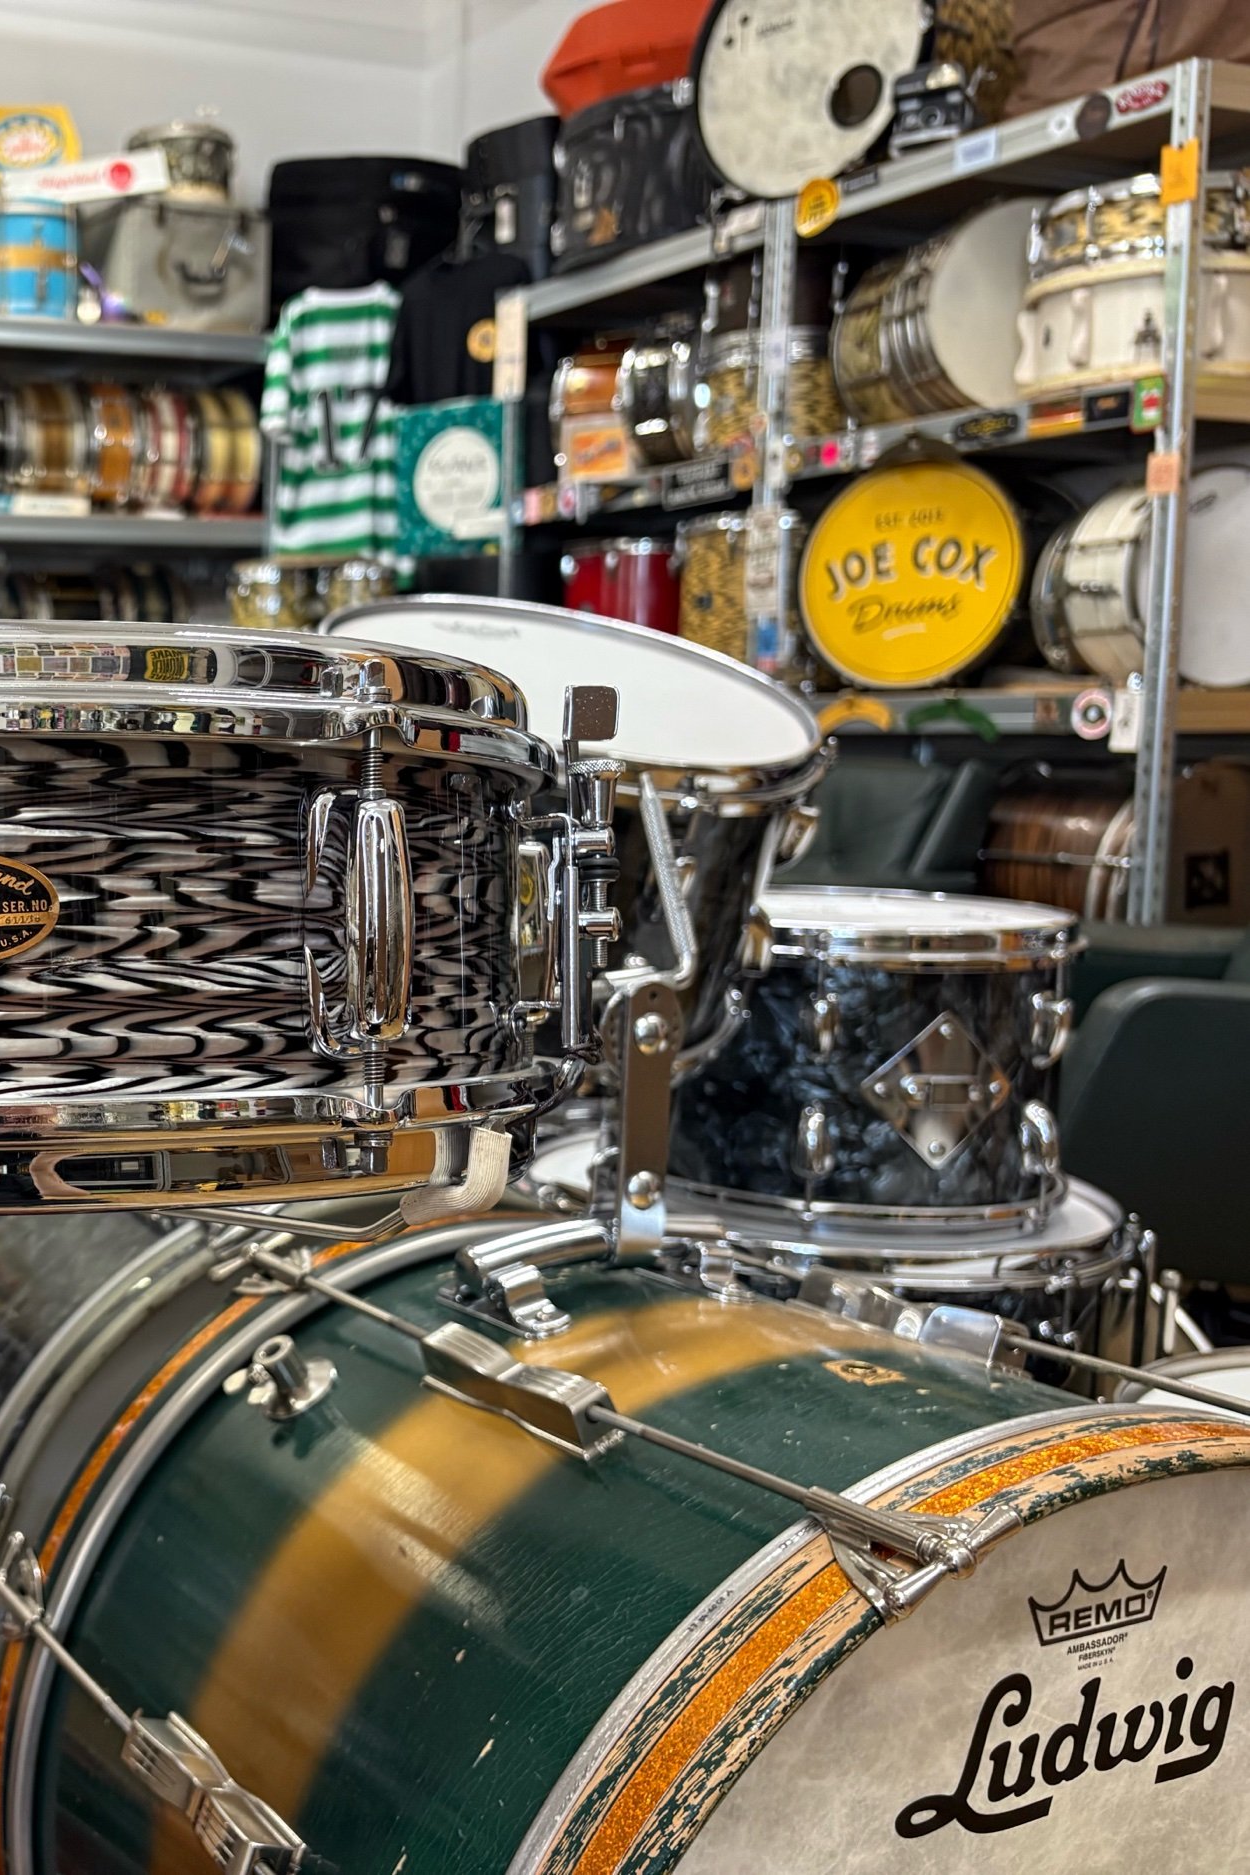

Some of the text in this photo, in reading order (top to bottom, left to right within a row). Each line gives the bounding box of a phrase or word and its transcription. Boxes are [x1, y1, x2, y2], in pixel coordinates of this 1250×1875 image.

[824, 538, 898, 601] JOE
[911, 534, 998, 592] COX
[894, 1656, 1235, 1839] Ludwig
